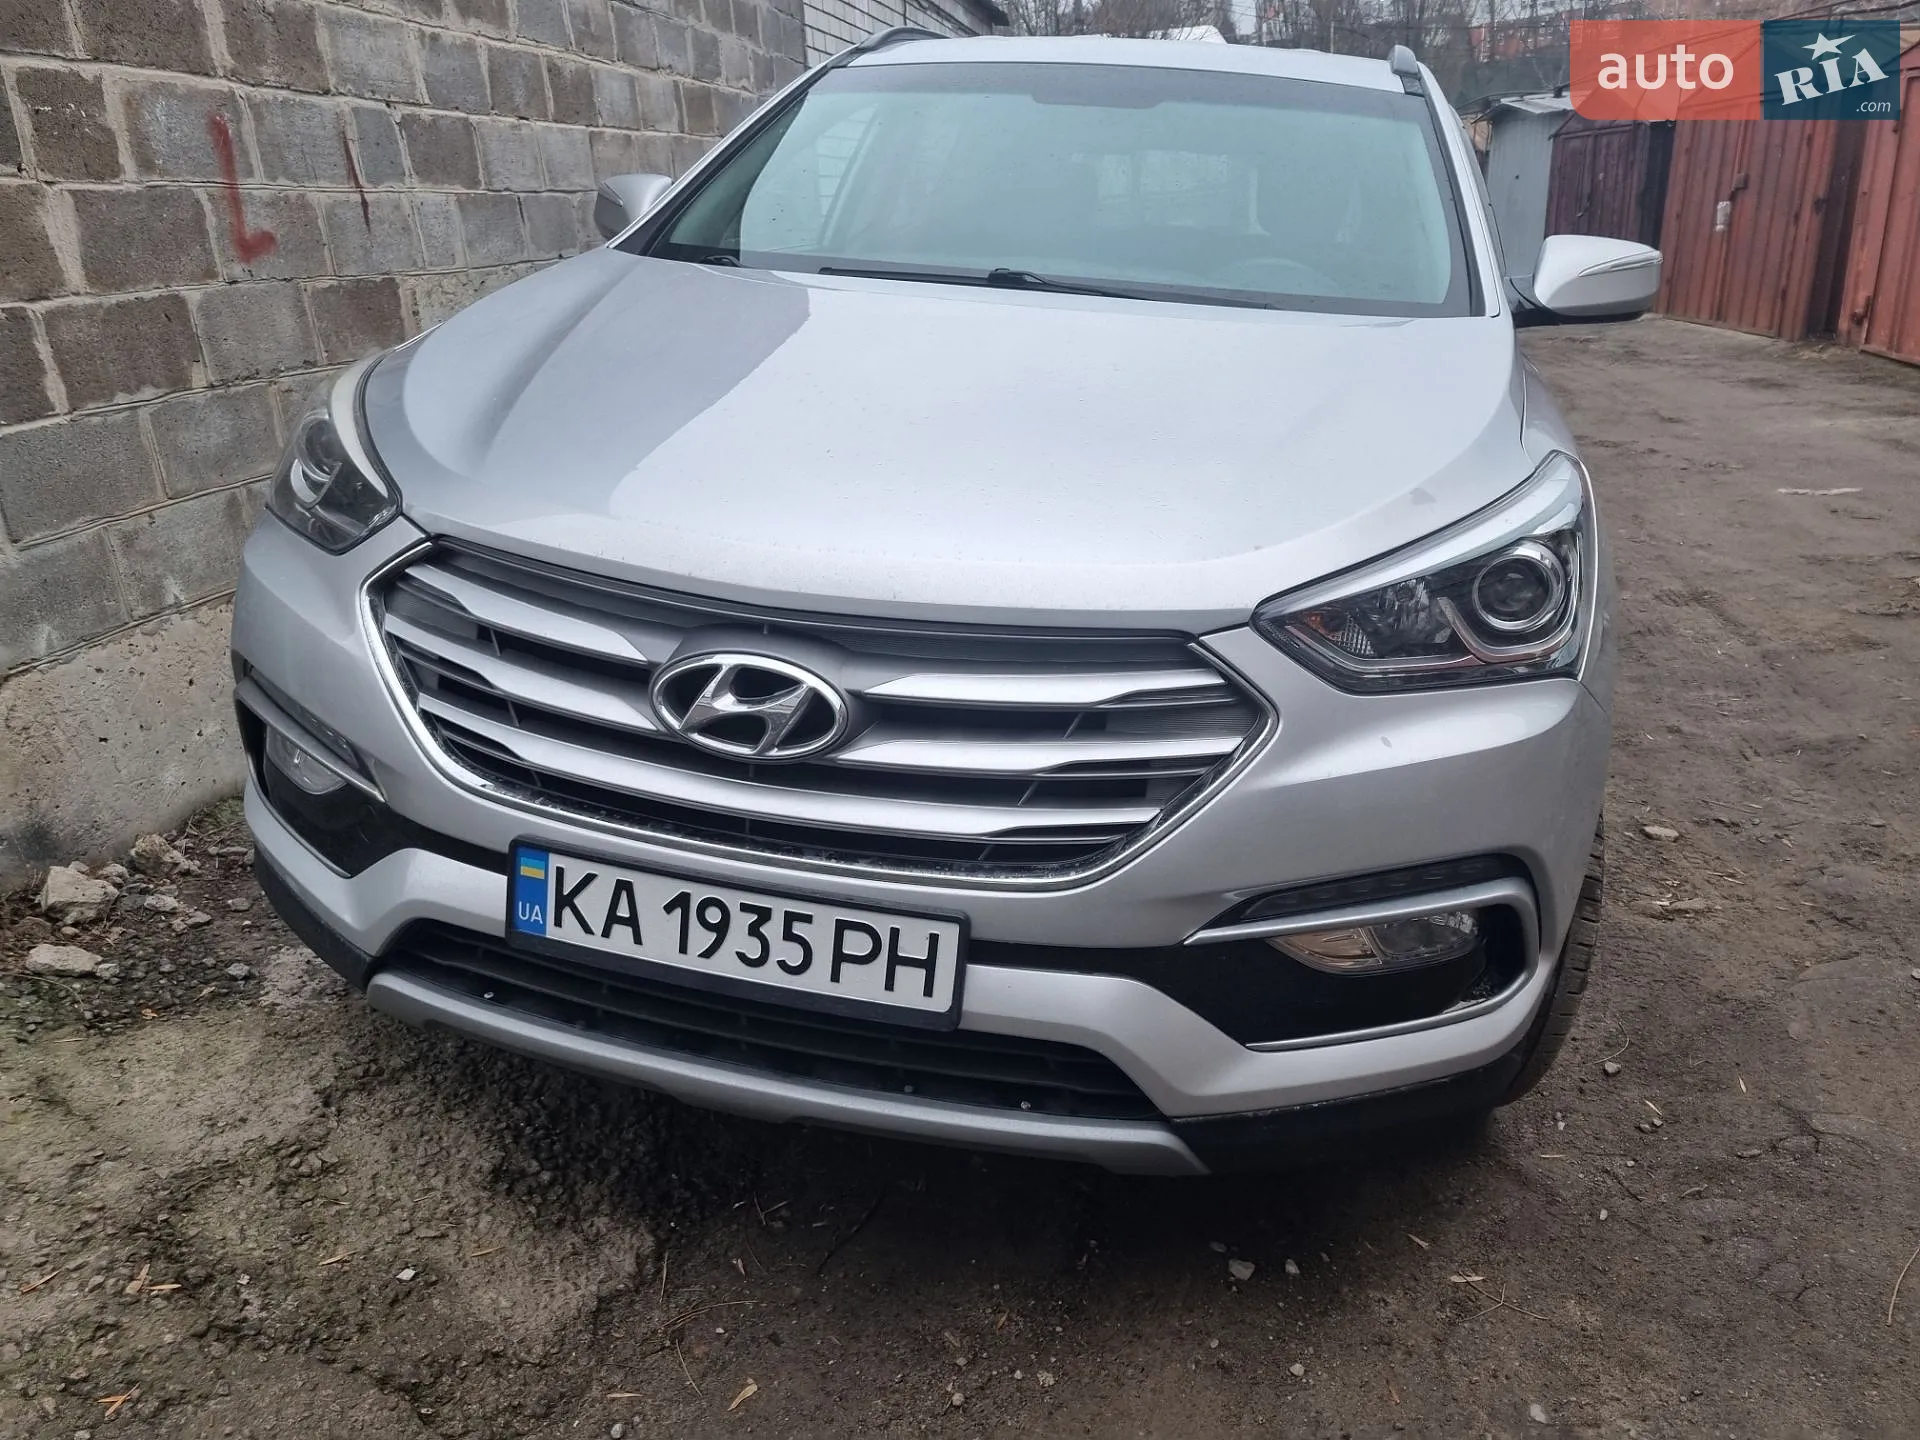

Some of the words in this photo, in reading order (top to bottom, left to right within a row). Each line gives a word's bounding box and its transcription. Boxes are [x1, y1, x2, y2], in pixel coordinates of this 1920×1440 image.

[518, 901, 543, 925] UA
[554, 866, 643, 945] KA
[662, 891, 813, 975] 1935
[830, 918, 940, 997] PH
